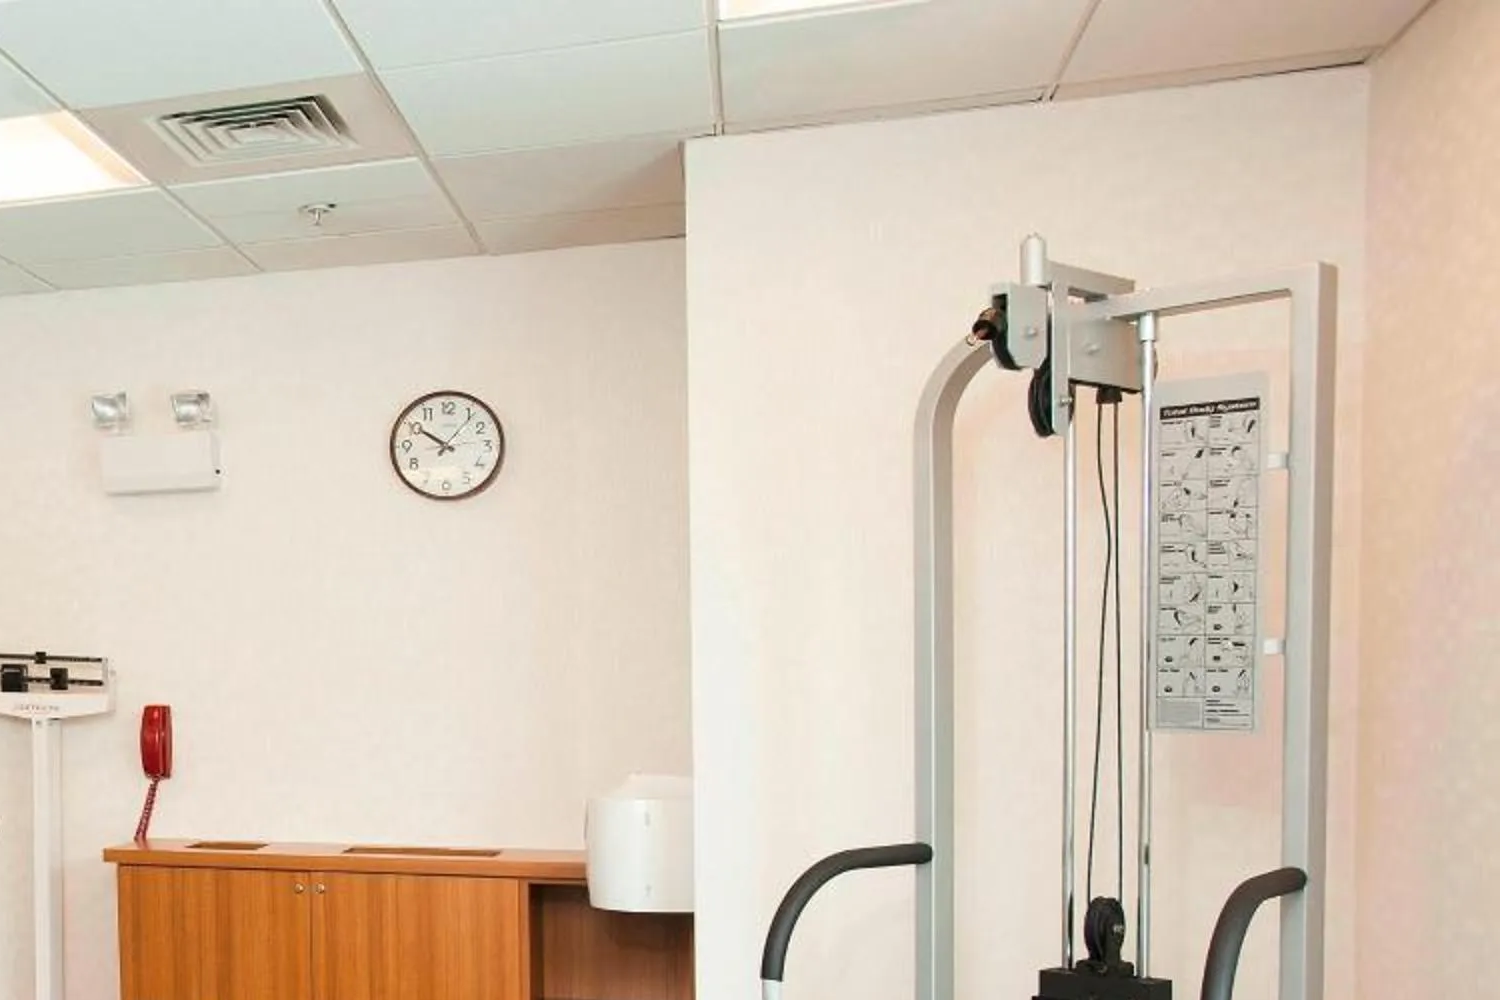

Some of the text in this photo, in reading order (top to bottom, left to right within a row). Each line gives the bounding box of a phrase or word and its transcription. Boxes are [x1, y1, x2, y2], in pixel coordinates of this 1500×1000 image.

[422, 407, 433, 421] 11
[441, 401, 456, 415] 12
[466, 407, 472, 421] 1
[475, 421, 486, 434] 2
[401, 439, 413, 453] 9
[483, 439, 493, 453] 3
[409, 457, 419, 470] 8
[441, 479, 452, 491] 6
